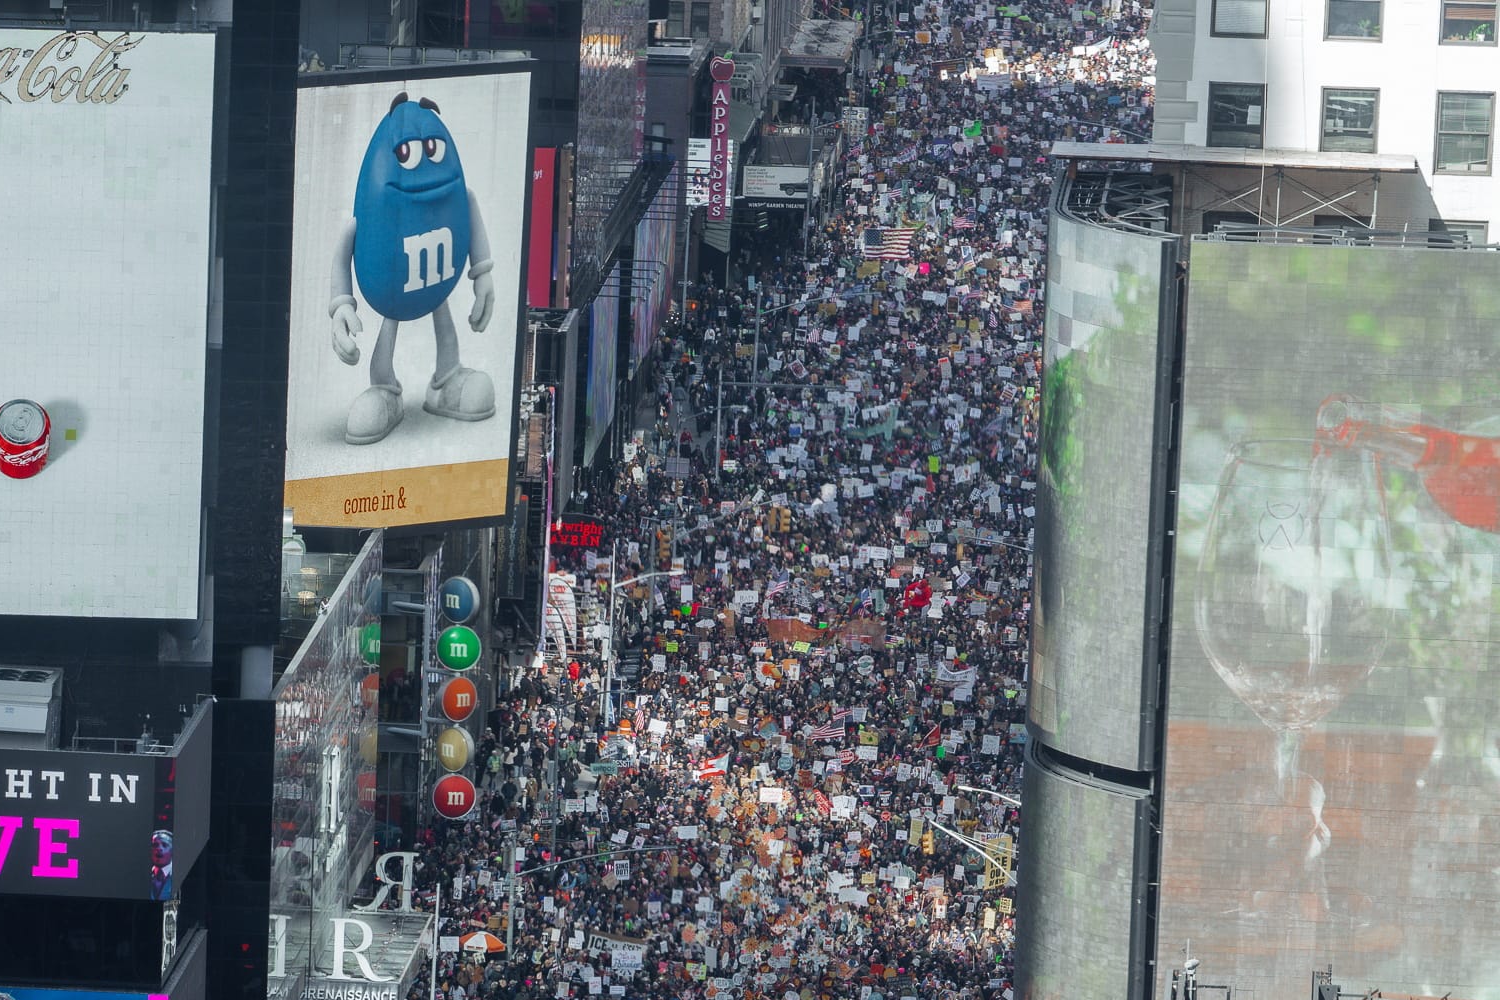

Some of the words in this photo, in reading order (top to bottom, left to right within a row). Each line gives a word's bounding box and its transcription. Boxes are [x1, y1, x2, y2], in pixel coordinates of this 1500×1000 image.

[345, 495, 379, 515] come
[382, 490, 394, 511] in
[397, 486, 407, 510] &
[445, 593, 460, 608] m
[450, 642, 468, 657] m
[456, 693, 470, 708] m
[441, 742, 454, 757] m
[87, 772, 140, 804] IN
[447, 791, 465, 806] m
